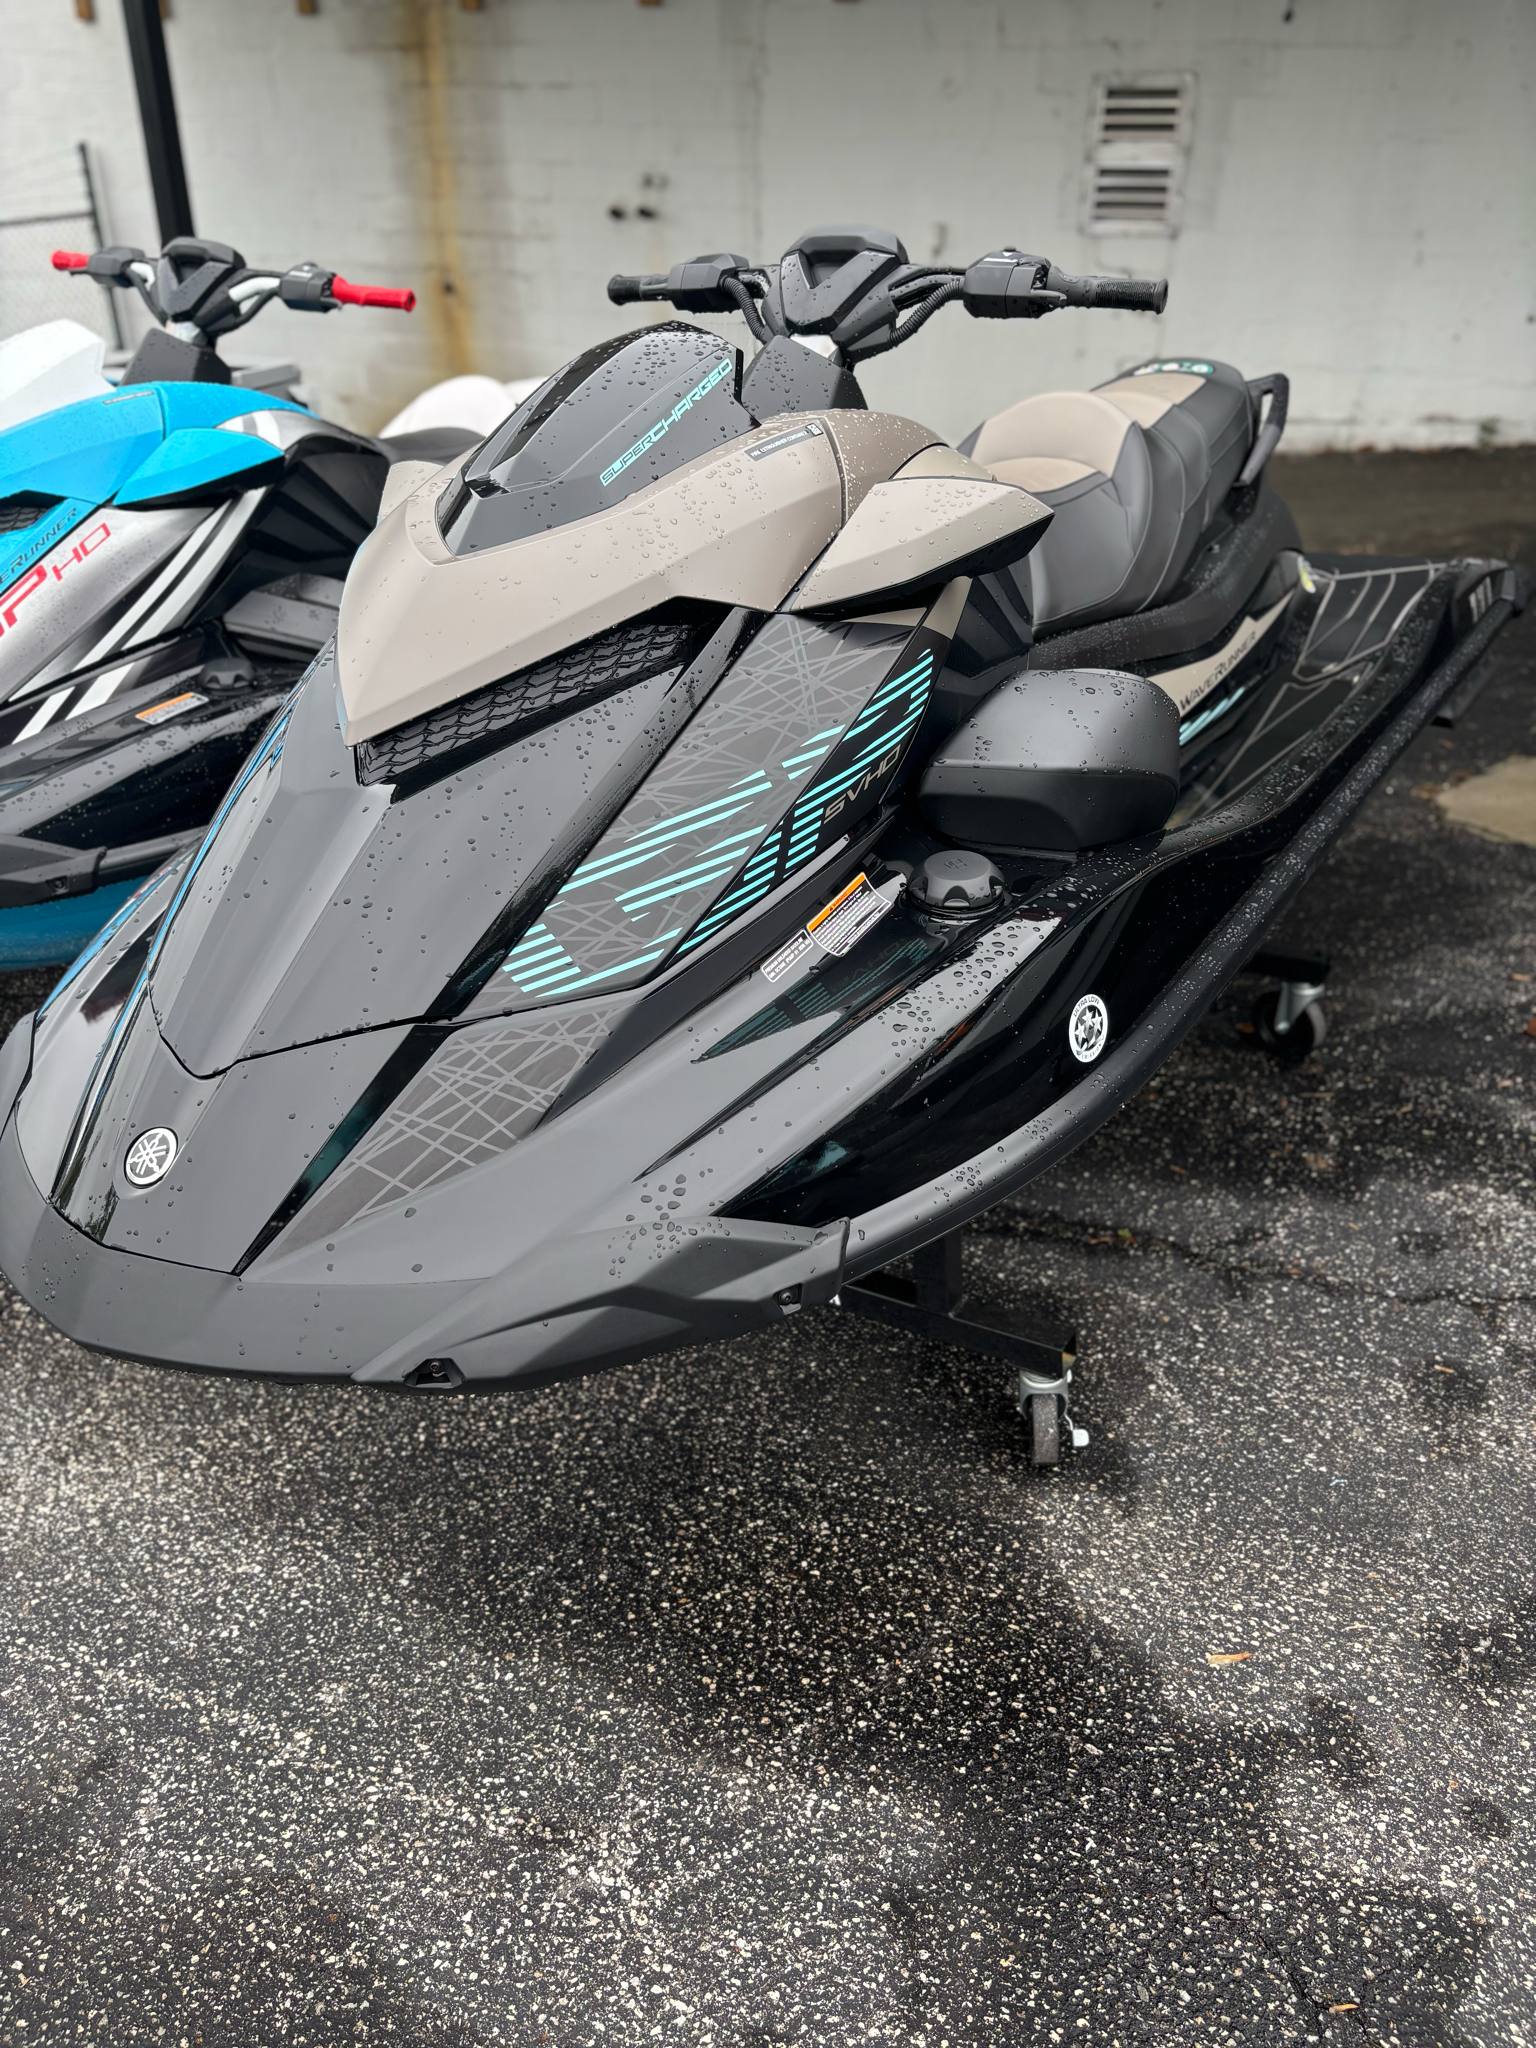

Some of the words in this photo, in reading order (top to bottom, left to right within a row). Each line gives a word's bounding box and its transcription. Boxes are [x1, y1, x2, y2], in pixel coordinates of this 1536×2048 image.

[600, 358, 733, 487] SUPERCHARGED
[0, 564, 48, 638] P
[823, 744, 901, 825] SVHO
